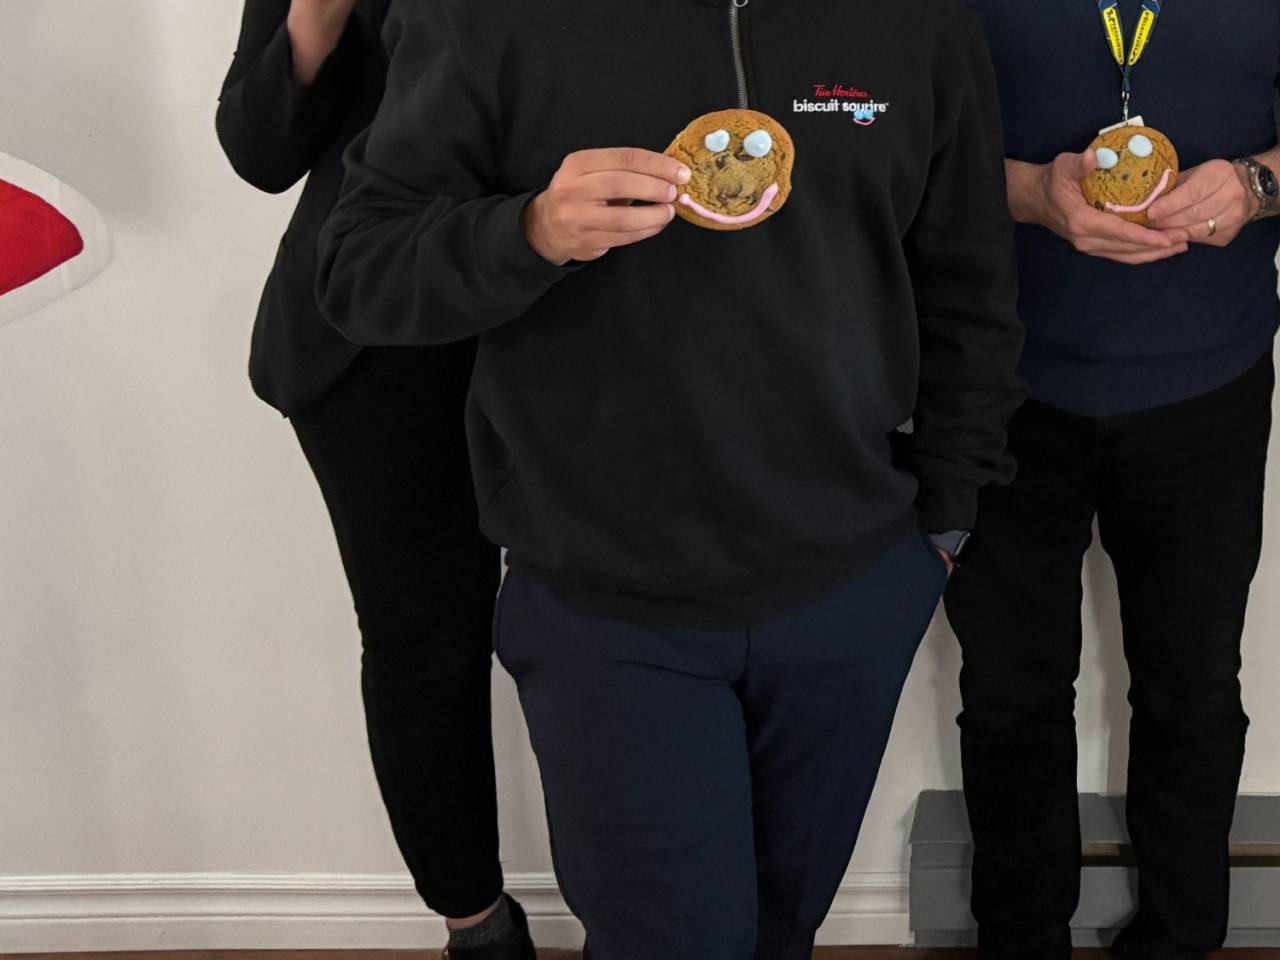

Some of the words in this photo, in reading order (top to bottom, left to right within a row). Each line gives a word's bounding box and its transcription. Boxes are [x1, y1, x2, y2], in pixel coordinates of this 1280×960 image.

[812, 84, 831, 97] Tim
[831, 84, 869, 98] Hortons
[793, 99, 840, 113] biscuit
[842, 99, 887, 113] sourire
